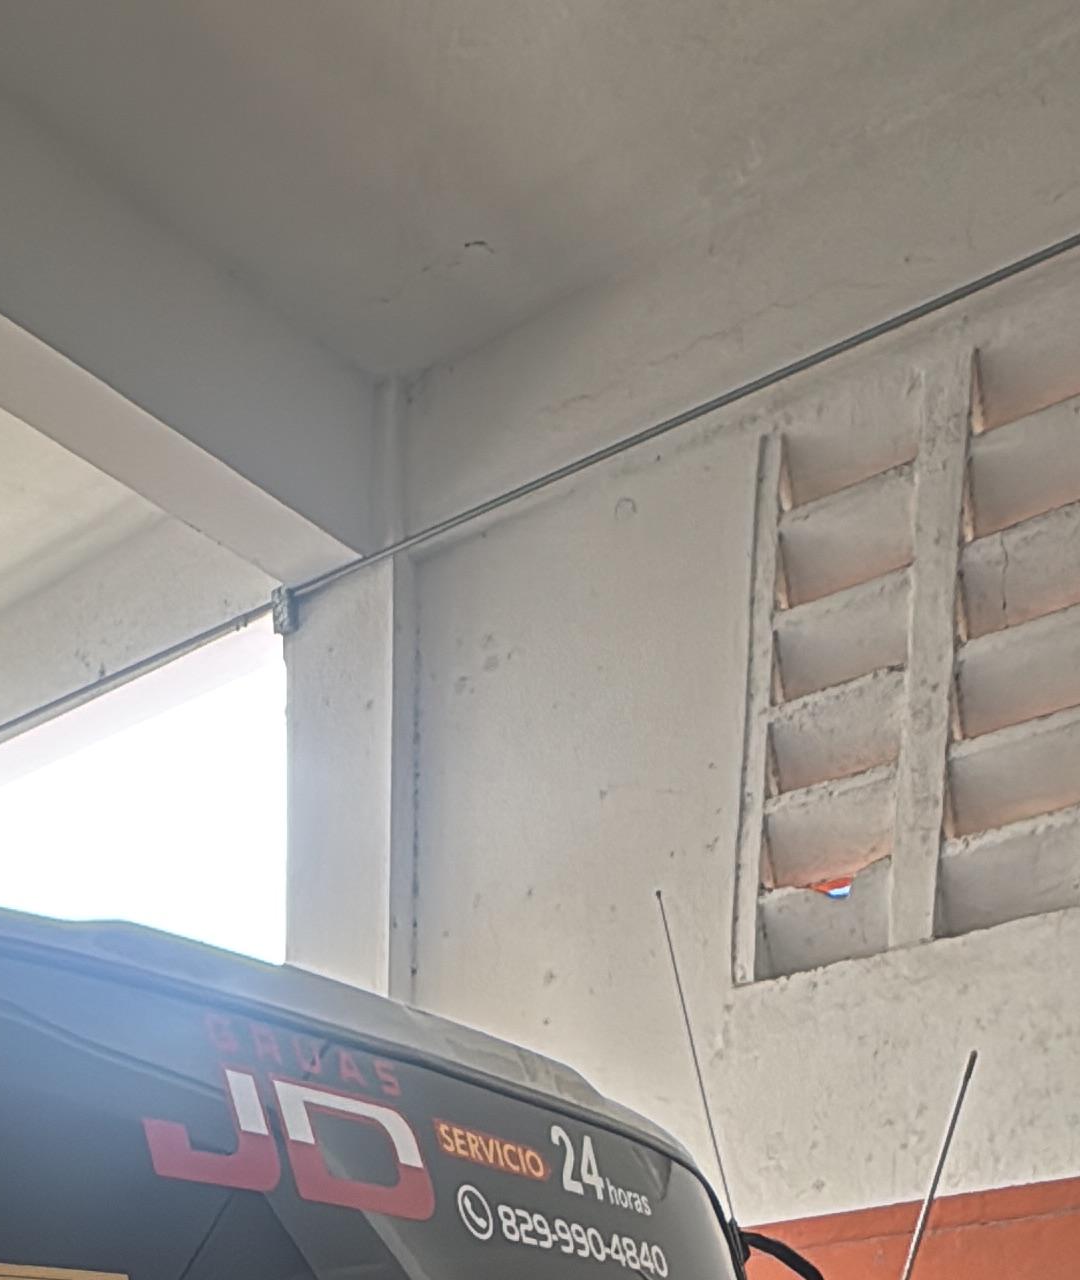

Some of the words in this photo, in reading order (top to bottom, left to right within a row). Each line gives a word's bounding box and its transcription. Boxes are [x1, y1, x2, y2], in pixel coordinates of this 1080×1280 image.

[142, 1063, 436, 1221] JD
[438, 1122, 545, 1179] SERVICIO
[550, 1124, 605, 1200] 24
[605, 1176, 653, 1217] horas
[497, 1203, 669, 1279] 829-990-4840
